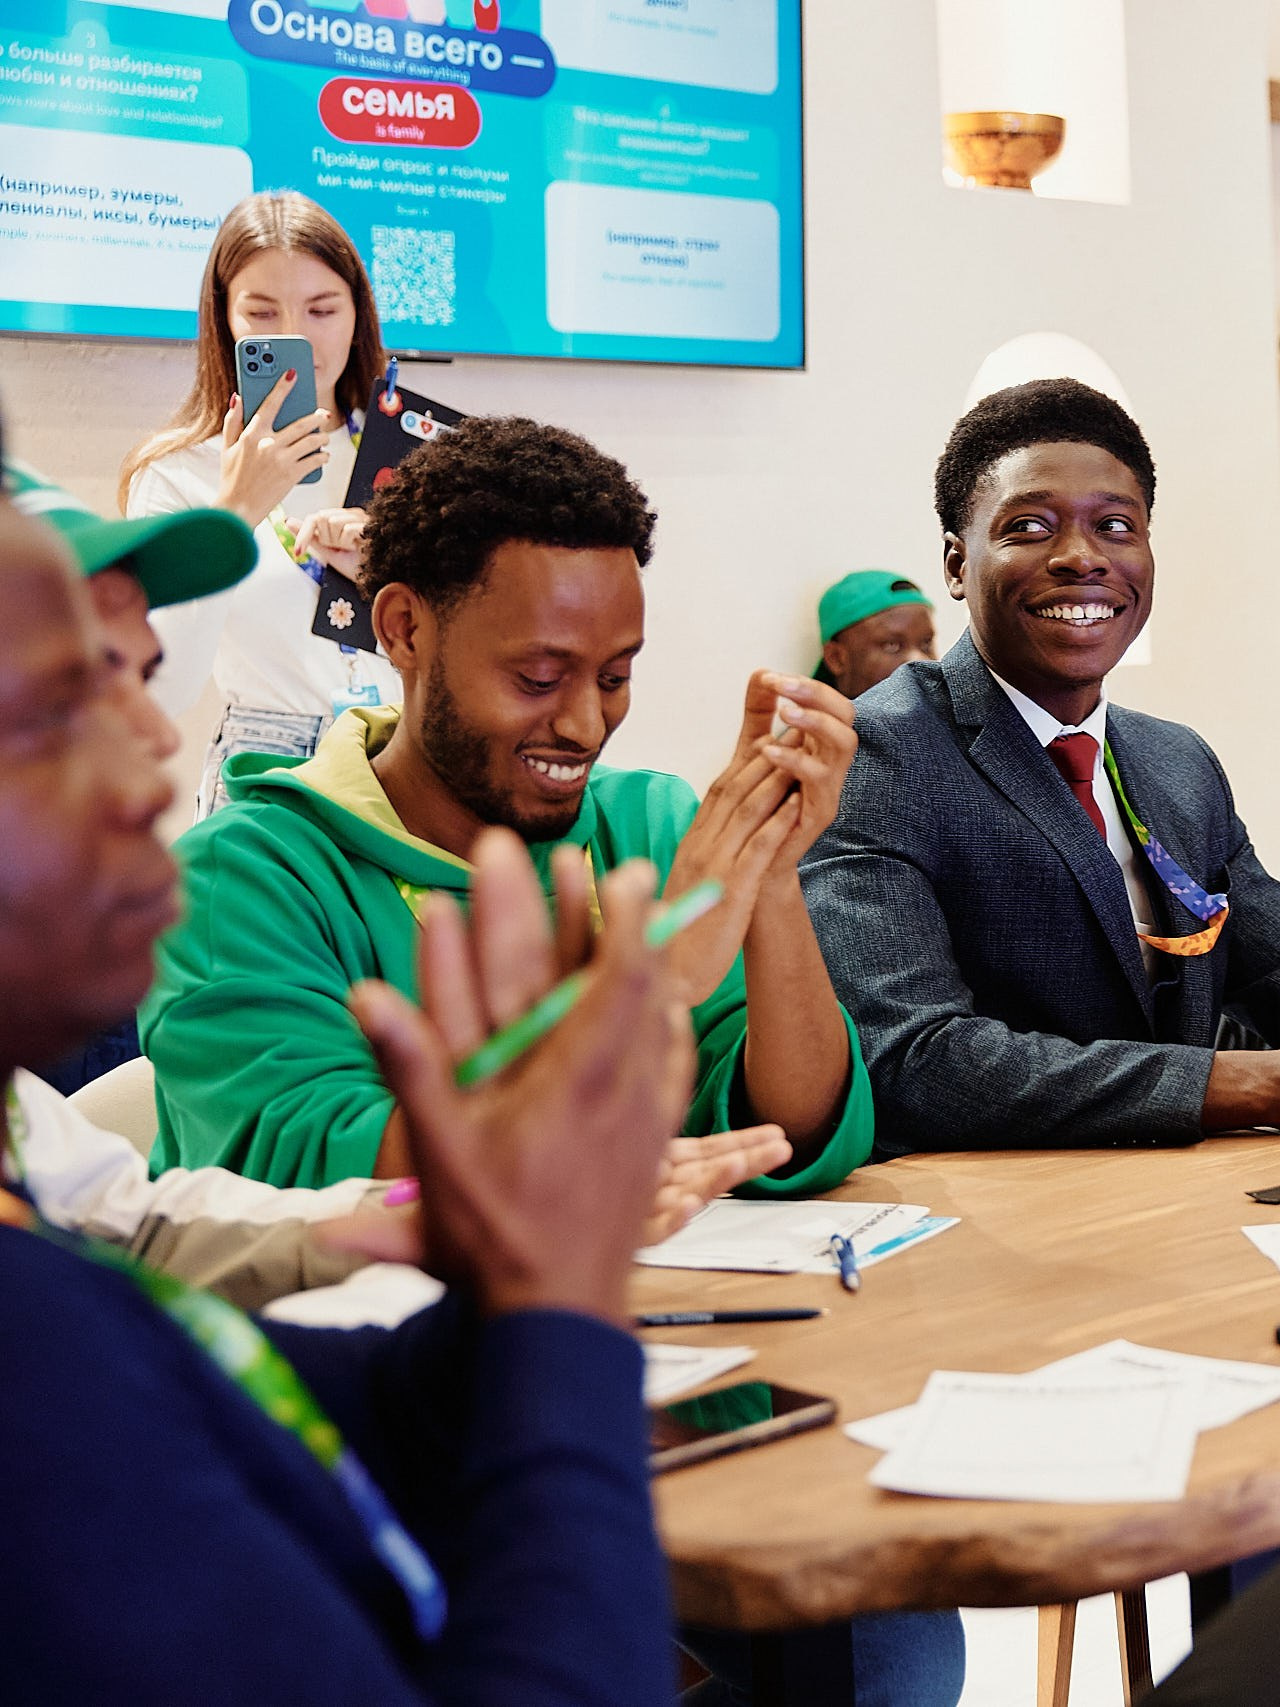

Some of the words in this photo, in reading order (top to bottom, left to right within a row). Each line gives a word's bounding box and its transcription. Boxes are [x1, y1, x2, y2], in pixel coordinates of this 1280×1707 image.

[250, 0, 397, 55] Основа
[404, 30, 503, 71] всего
[9, 41, 84, 67] больше
[88, 54, 203, 82] разбирается
[60, 74, 72, 87] и
[76, 76, 199, 103] отношениях?
[342, 86, 456, 120] семья
[111, 188, 183, 207] зумеры,
[93, 208, 142, 225] иксы,
